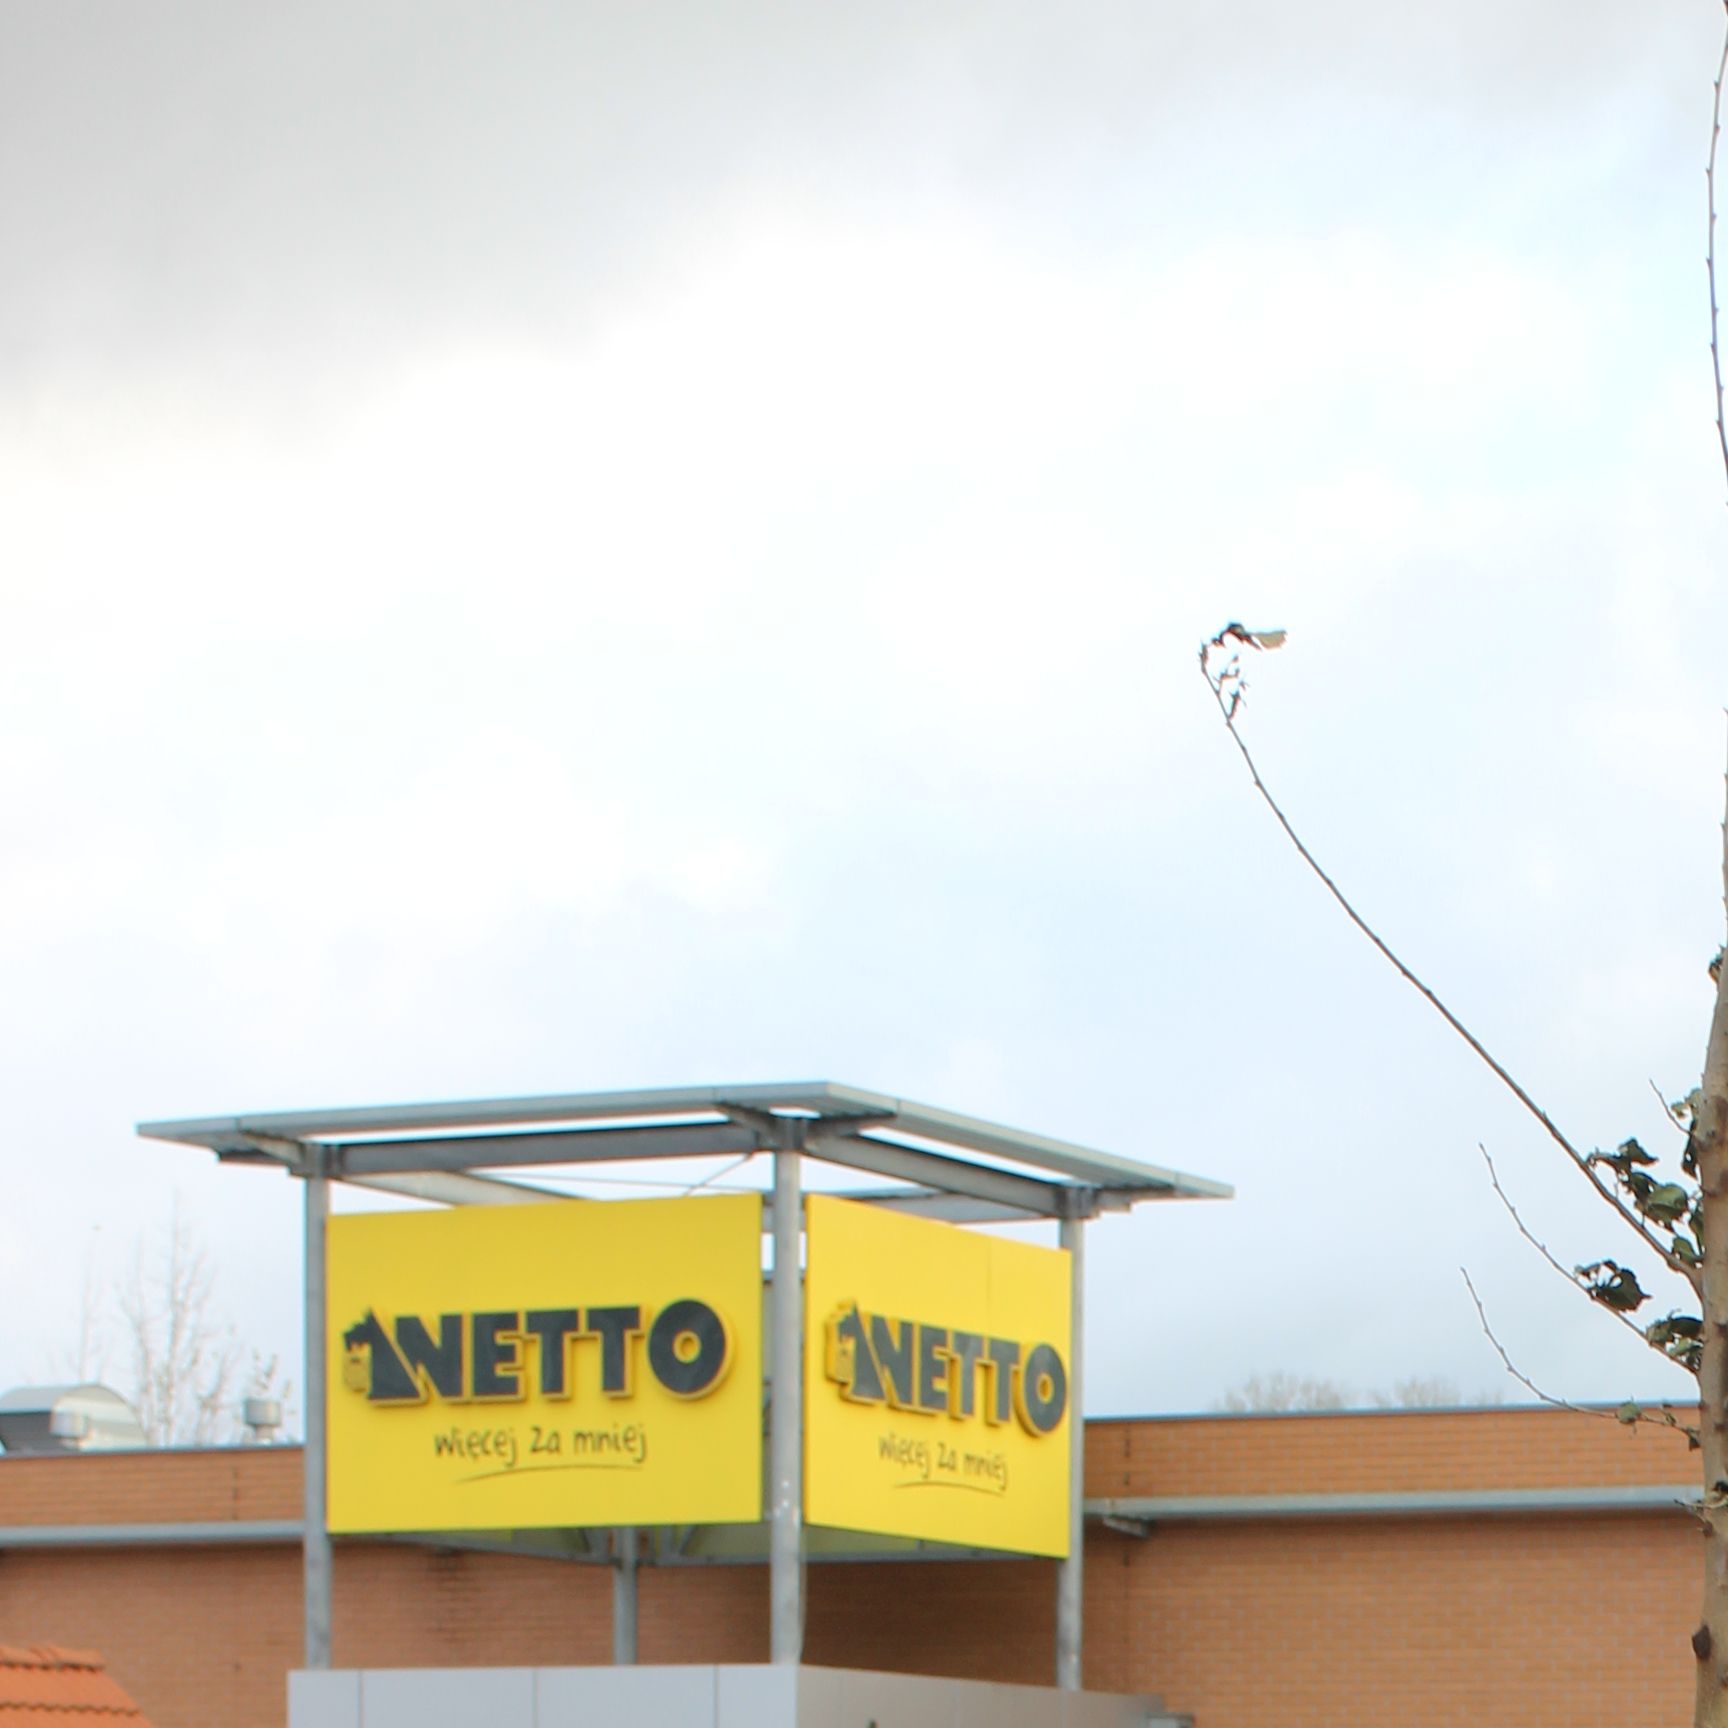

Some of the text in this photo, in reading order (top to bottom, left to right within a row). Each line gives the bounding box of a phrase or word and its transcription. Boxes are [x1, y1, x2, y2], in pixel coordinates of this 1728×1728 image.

[343, 1298, 727, 1402] NETTO
[832, 1301, 1067, 1434] NETTO
[433, 1425, 519, 1468] więcej
[574, 1422, 648, 1464] mniej
